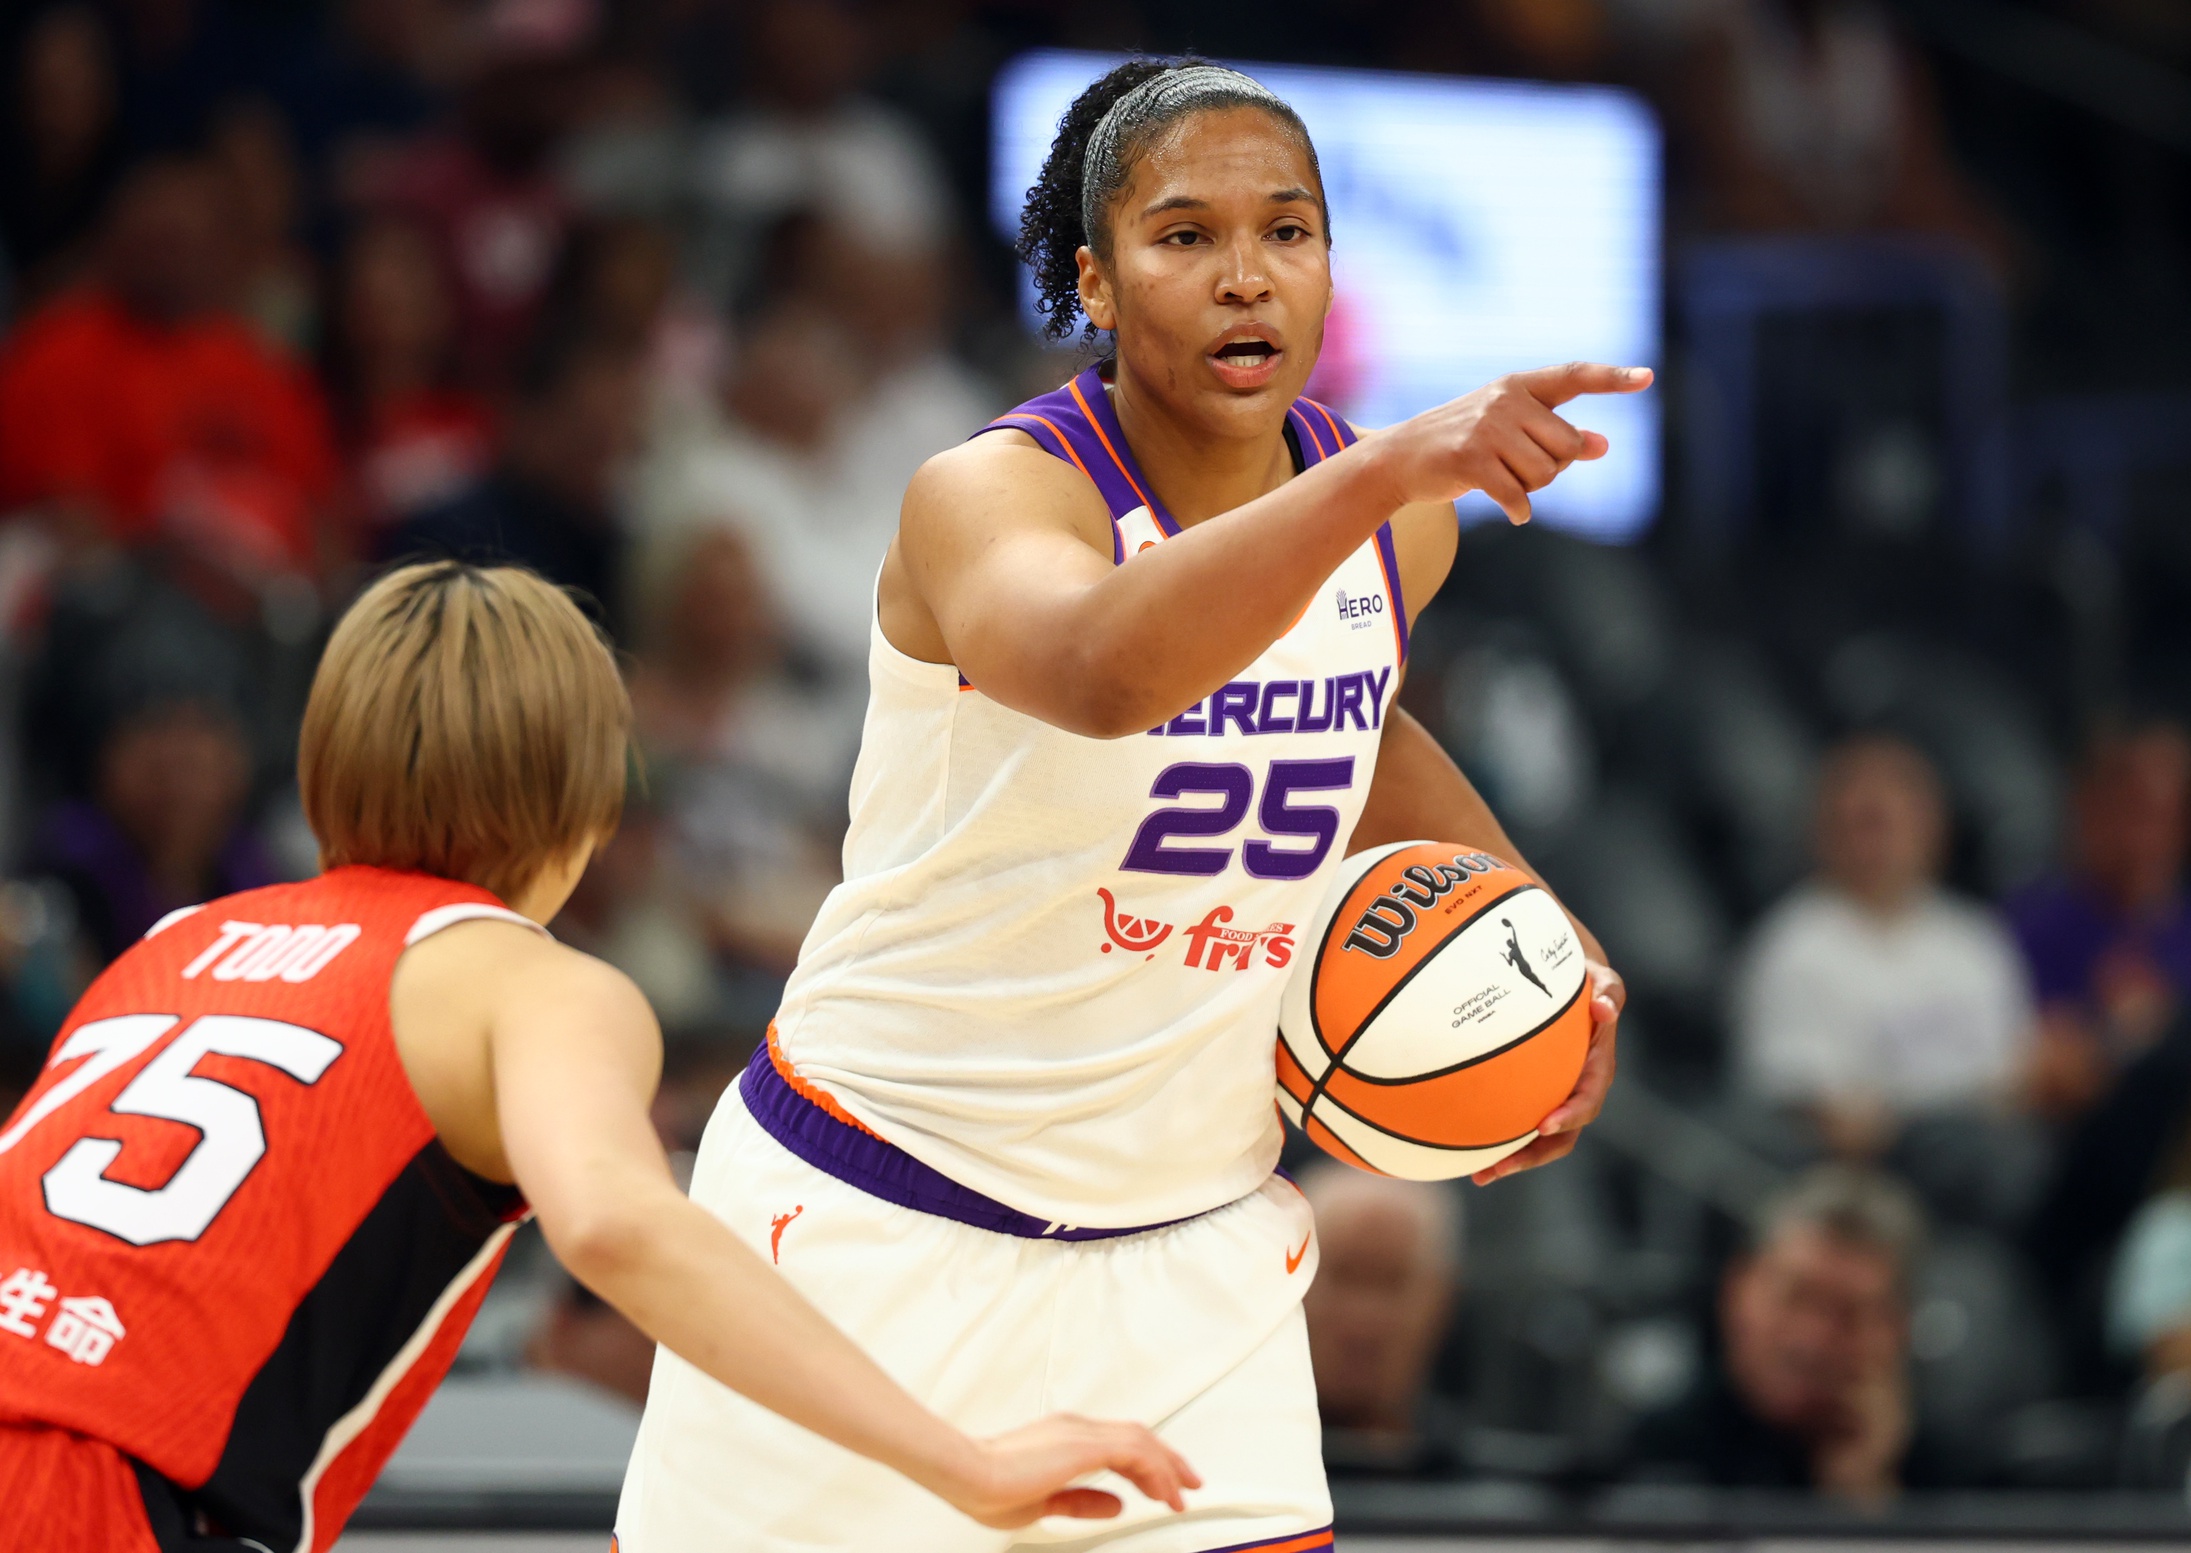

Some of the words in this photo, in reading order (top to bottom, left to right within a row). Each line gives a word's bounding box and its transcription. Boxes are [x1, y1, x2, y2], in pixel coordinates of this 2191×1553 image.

[1336, 590, 1383, 620] HERO
[1351, 620, 1372, 630] BREAD
[1147, 665, 1391, 736] ERCURY
[1118, 755, 1356, 881] 25
[1220, 929, 1253, 942] FOOD
[1341, 852, 1515, 960] Wilson
[181, 919, 362, 984] TODO
[1451, 1004, 1484, 1028] GAME
[1484, 989, 1511, 1008] BALL
[1453, 984, 1500, 1015] OFFICIAL
[0, 1012, 345, 1247] 75
[0, 1266, 127, 1367] 生命
